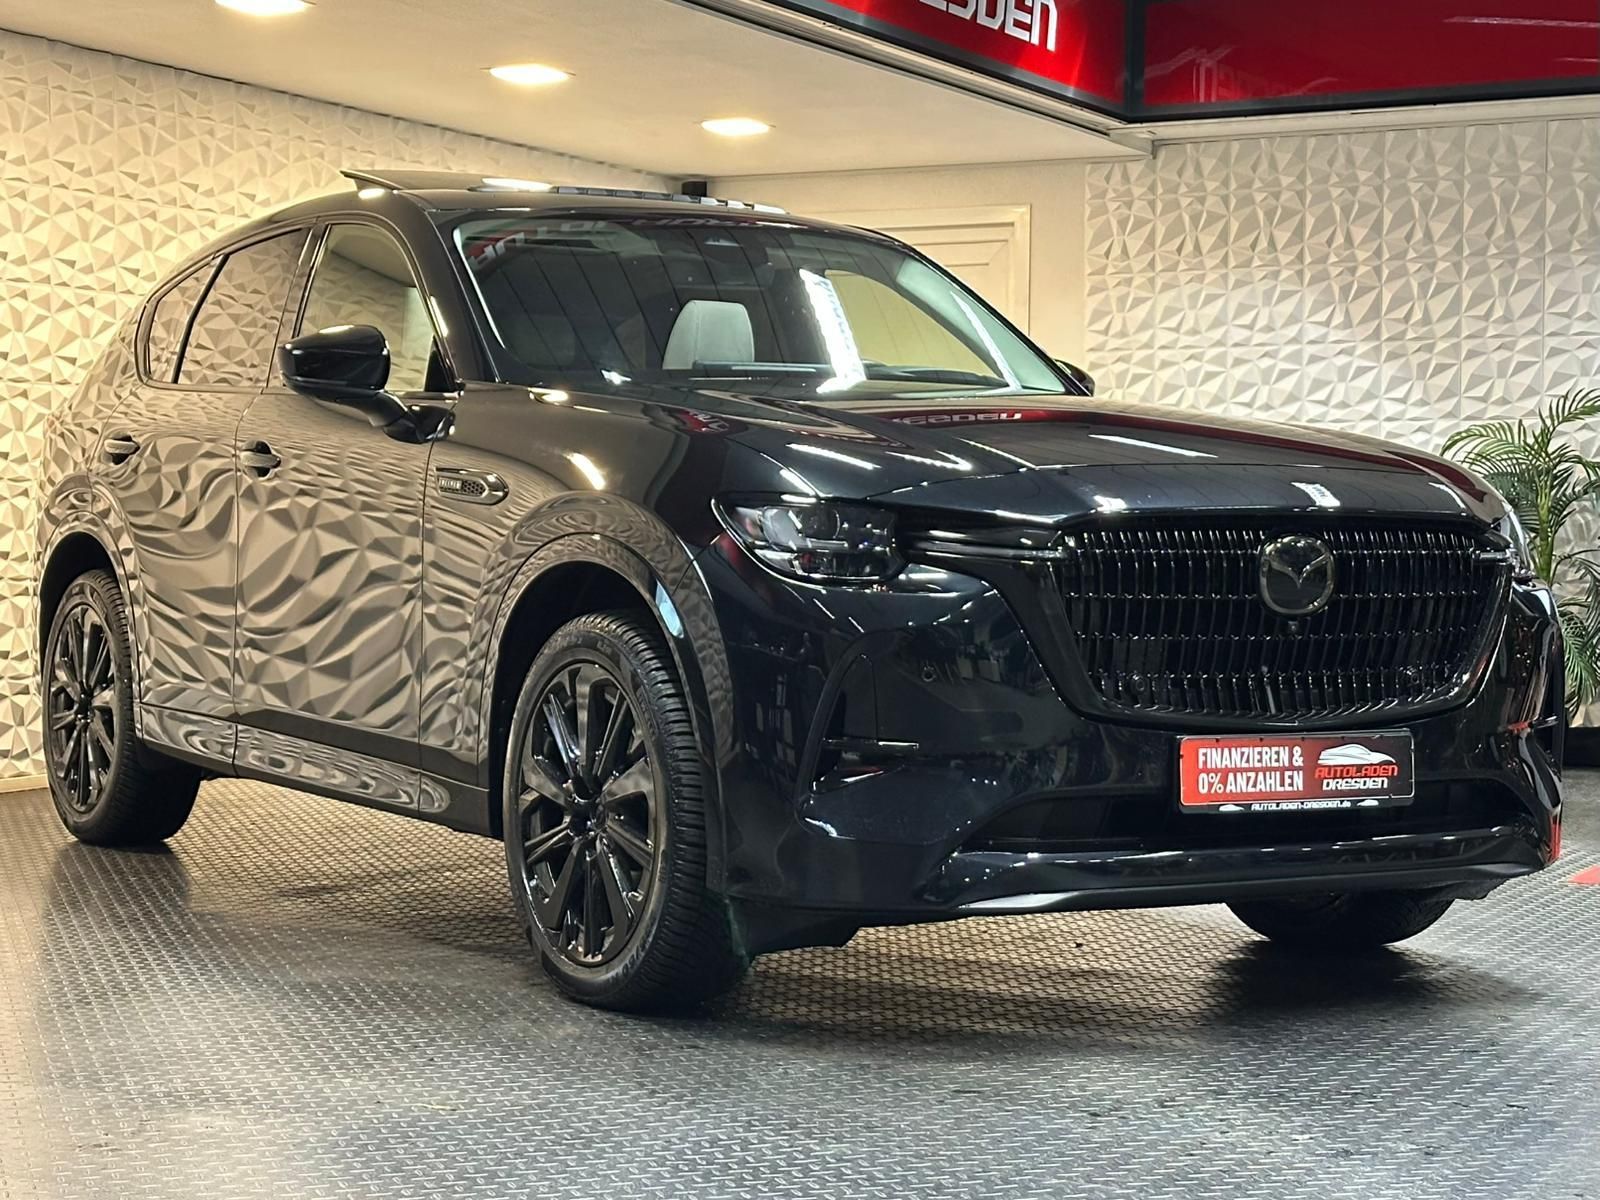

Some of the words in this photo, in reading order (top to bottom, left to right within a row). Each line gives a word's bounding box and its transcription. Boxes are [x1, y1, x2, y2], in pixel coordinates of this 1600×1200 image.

[919, 0, 1057, 52] DEN
[1198, 746, 1289, 769] FINANZIEREN
[1292, 745, 1304, 767] &
[1198, 772, 1224, 794] 0%
[1225, 770, 1304, 793] ANZAHLEN
[1315, 765, 1398, 778] AUTOLADEN
[1322, 777, 1388, 791] DRESDEN
